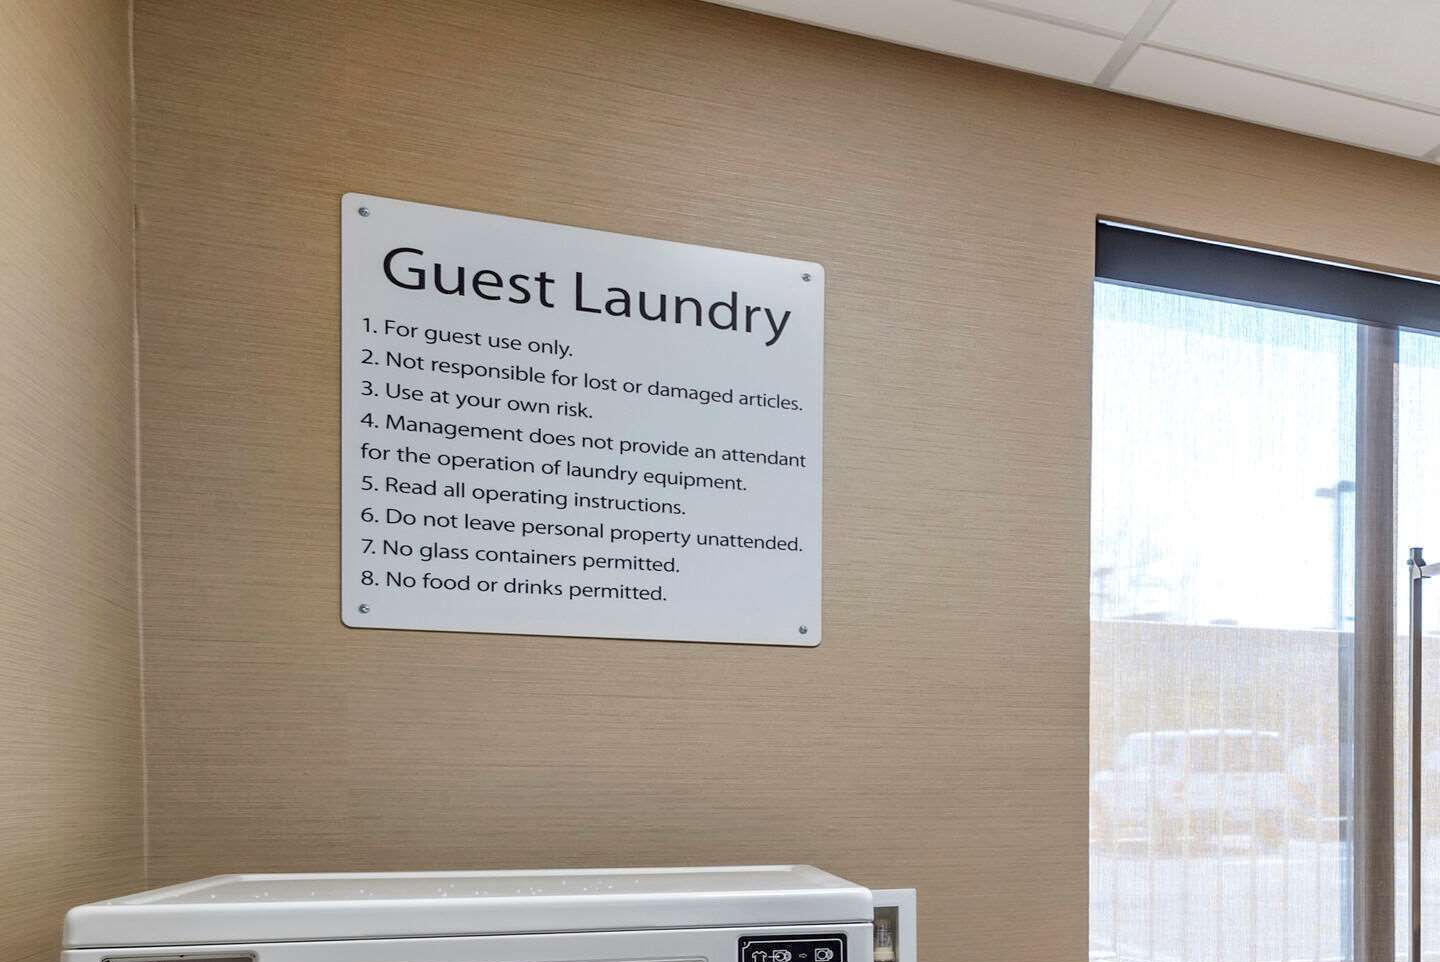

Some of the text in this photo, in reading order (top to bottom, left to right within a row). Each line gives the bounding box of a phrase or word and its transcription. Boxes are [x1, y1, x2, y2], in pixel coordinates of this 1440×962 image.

[383, 247, 791, 347] Guest Laundry
[363, 317, 573, 360] 1. For guest use only.
[361, 349, 803, 411] 2. Not responsible for lost or damaged articles.
[361, 380, 592, 419] 3. Use at your own risk.
[360, 413, 806, 468] 4. Management does not provide an attendant
[360, 442, 747, 491] for the operation of laundry equipment.
[361, 475, 686, 515] 5. Read all operating instructions.
[361, 507, 803, 552] 6. Do not leave personal property unattended.
[361, 538, 680, 573] 7. No glass containers permitted.
[361, 570, 667, 601] 8. No food or drinks permitted.
